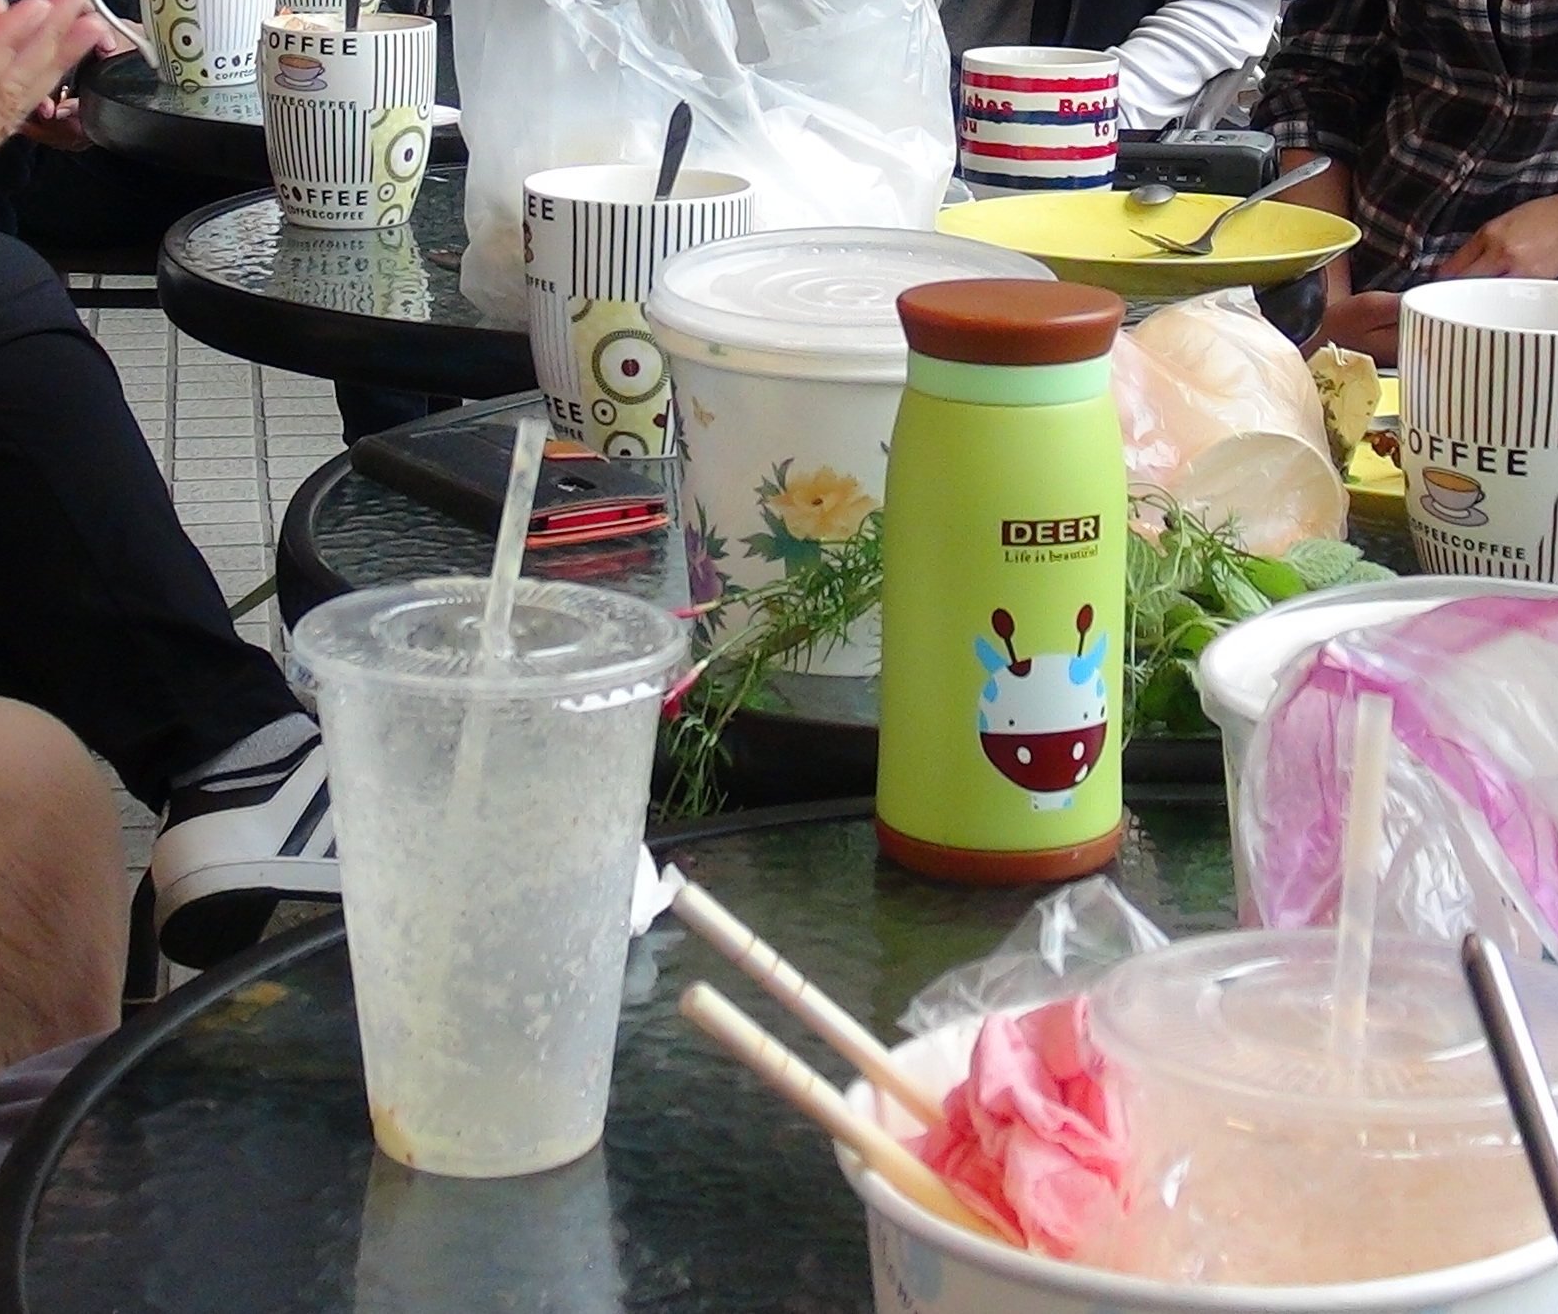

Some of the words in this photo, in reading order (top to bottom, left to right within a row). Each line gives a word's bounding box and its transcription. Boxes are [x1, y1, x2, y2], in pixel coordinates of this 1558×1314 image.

[268, 31, 358, 56] OFFEE
[1008, 516, 1097, 545] DEER
[1004, 548, 1032, 564] Life
[1034, 548, 1046, 564] is
